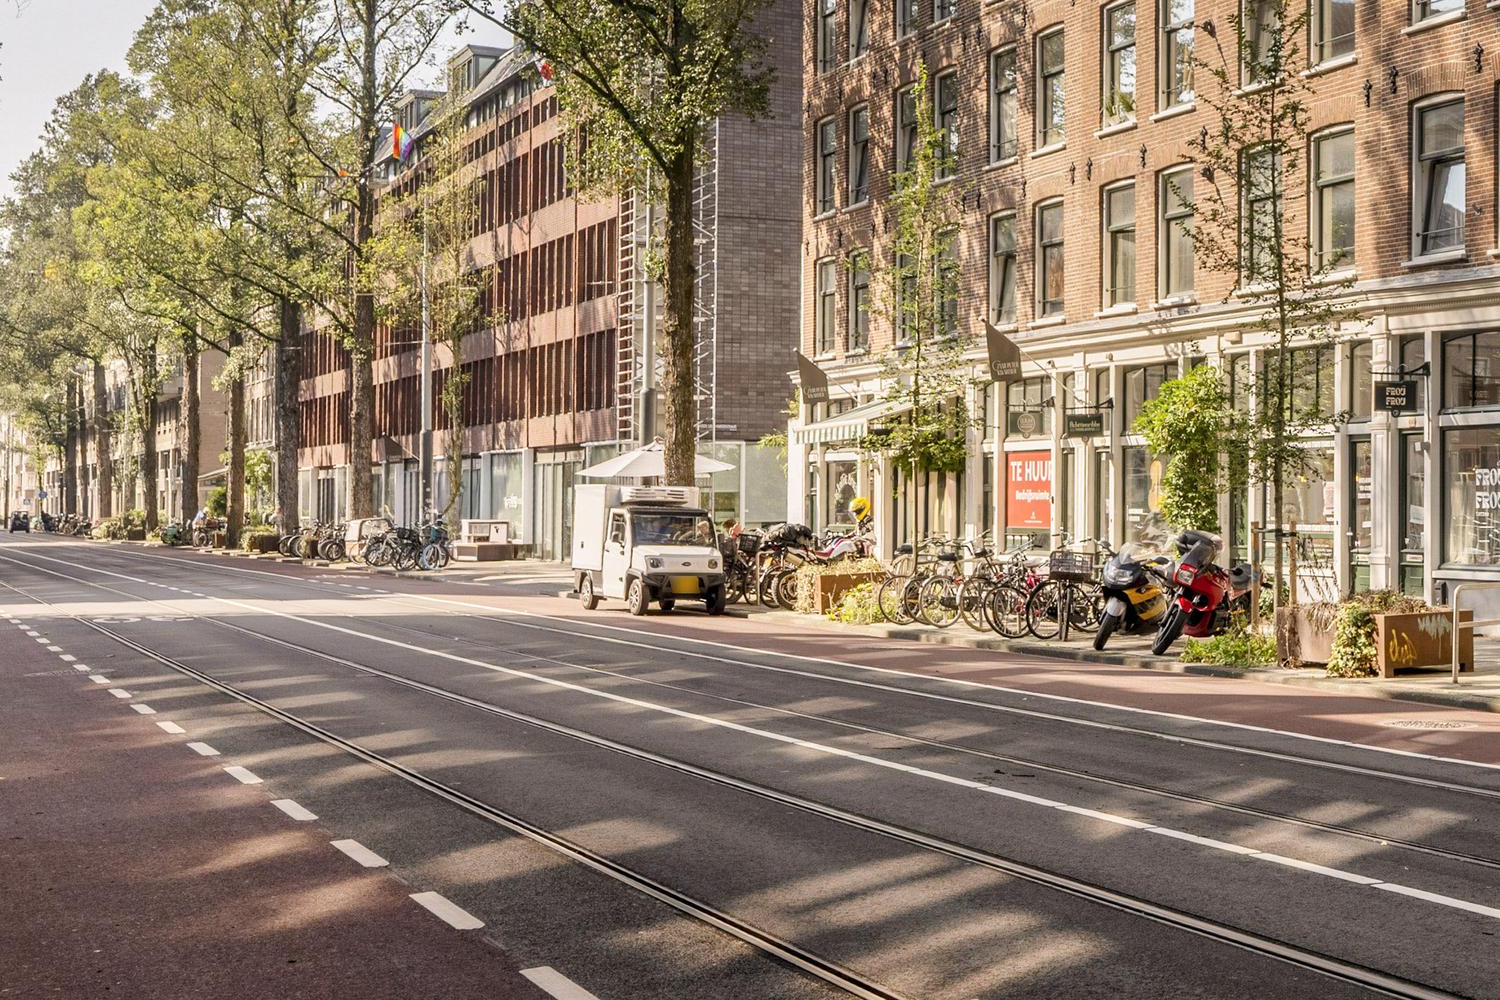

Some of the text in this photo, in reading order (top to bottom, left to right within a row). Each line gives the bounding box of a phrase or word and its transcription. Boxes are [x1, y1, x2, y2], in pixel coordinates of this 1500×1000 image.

[1386, 387, 1406, 396] FROU
[1386, 397, 1406, 405] FROU
[1010, 461, 1023, 482] TE
